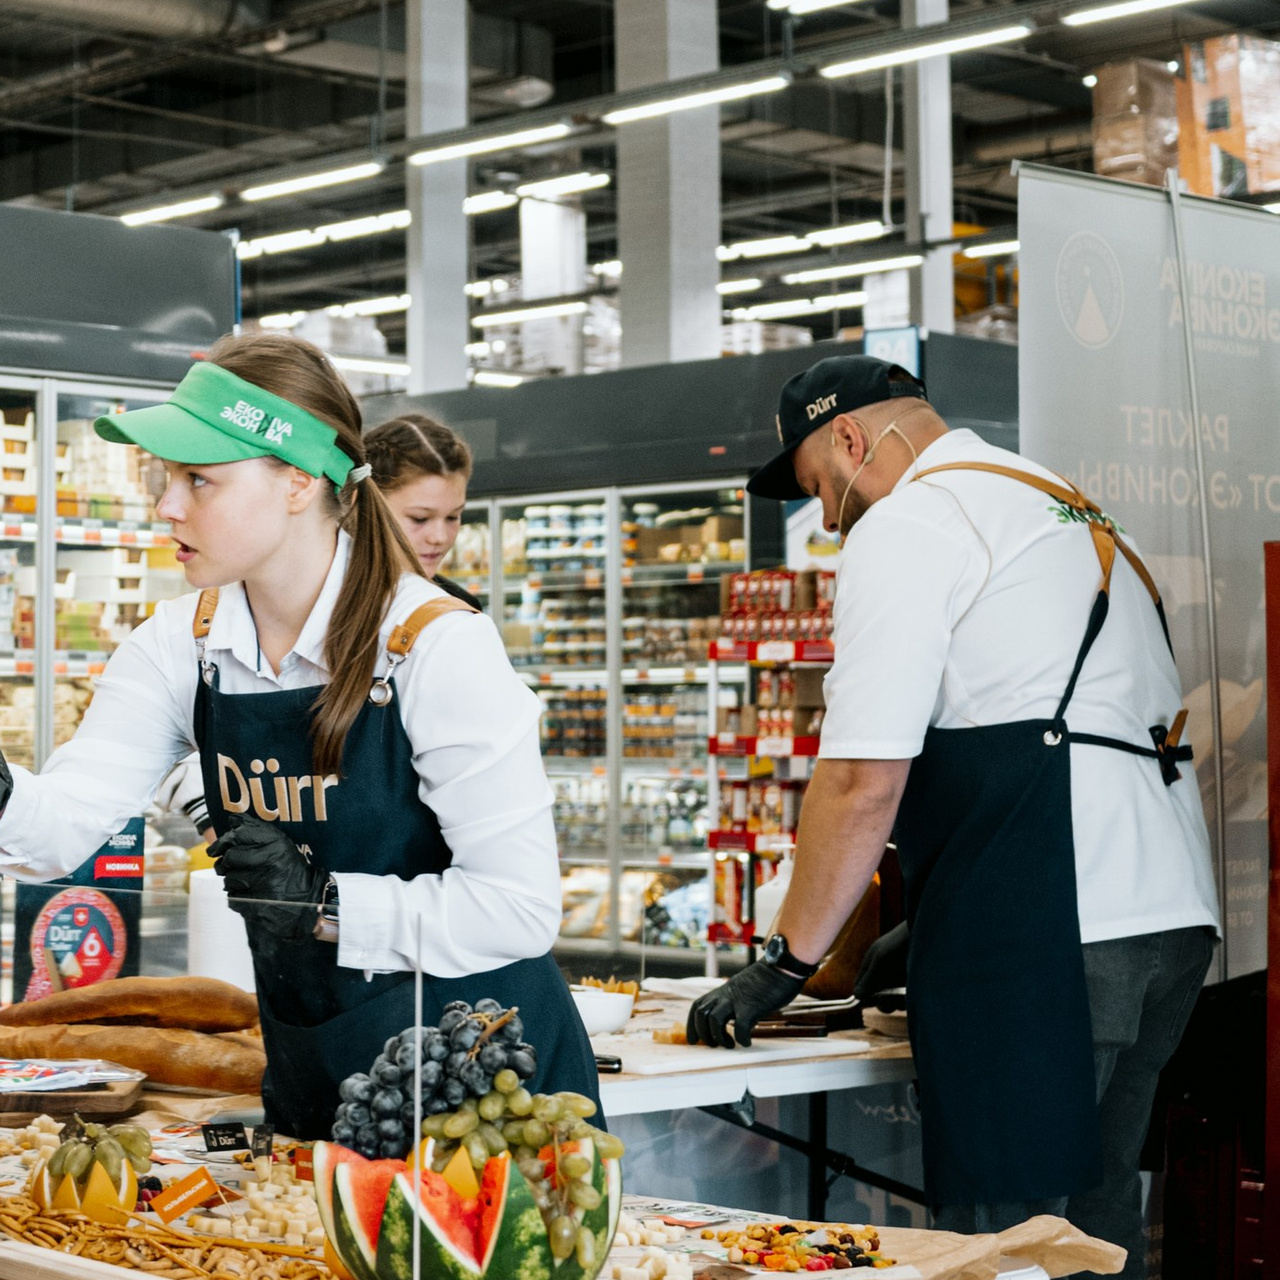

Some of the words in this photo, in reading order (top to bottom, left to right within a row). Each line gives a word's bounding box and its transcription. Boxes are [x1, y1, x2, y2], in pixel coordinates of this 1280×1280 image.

[219, 405, 282, 445] ЭКОНИВА
[233, 400, 293, 437] EKONIVA
[805, 393, 838, 421] Dürr
[217, 752, 339, 822] Dürr
[83, 932, 101, 958] 6
